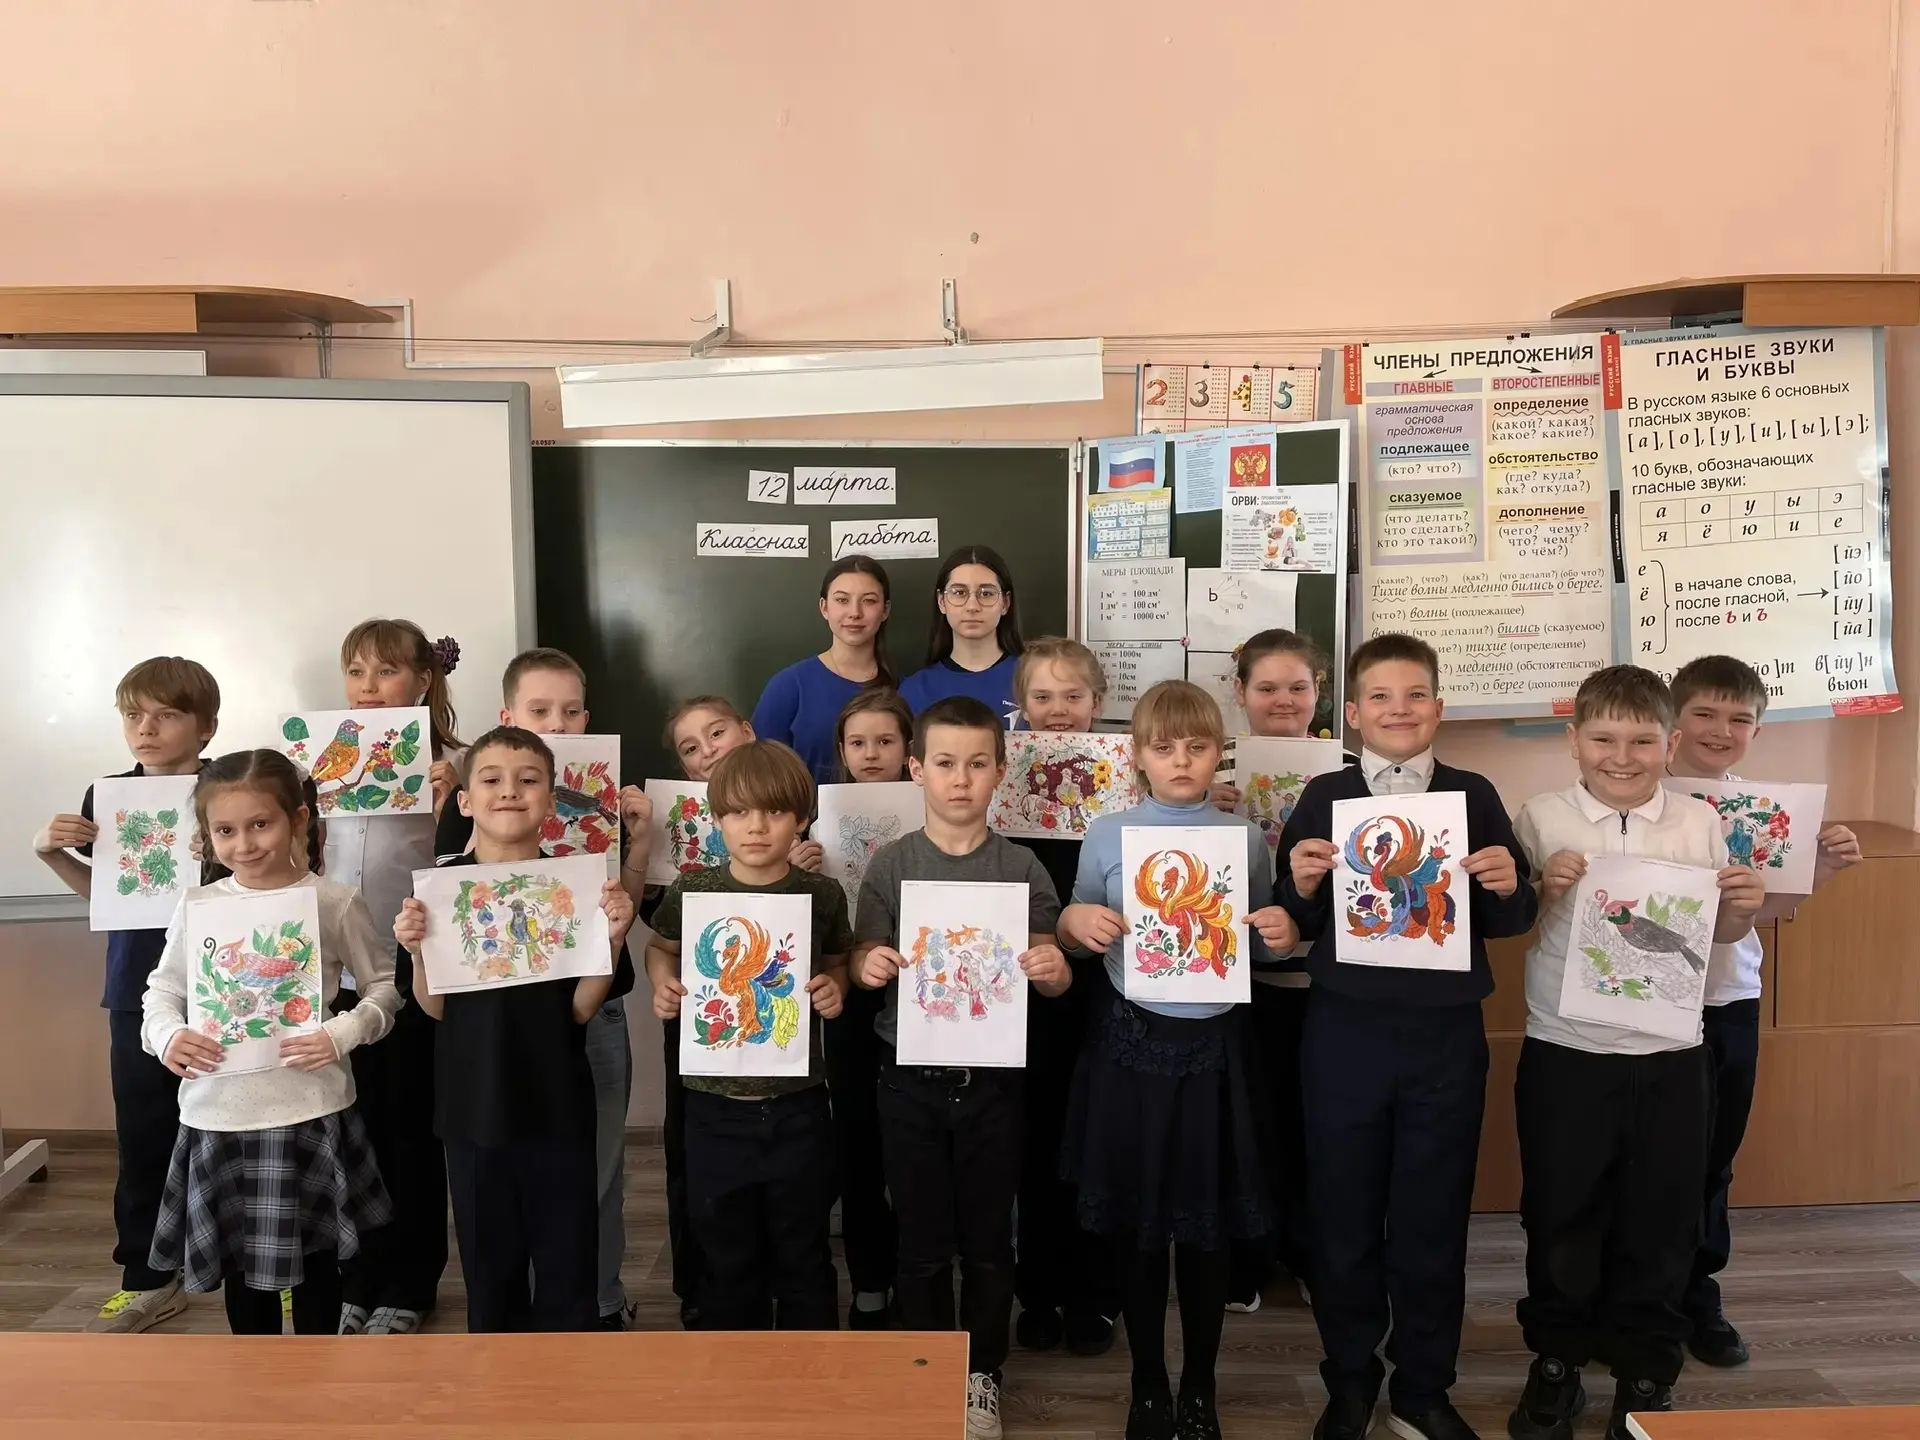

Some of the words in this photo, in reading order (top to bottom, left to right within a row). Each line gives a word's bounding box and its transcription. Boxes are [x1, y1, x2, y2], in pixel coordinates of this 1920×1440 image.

[1374, 353, 1440, 370] ЧЛЕНЫ
[1451, 345, 1594, 368] ПРЕДЛОЖЕНИЯ
[1656, 344, 1756, 368] ГЛАСНЫЕ
[1770, 338, 1834, 356] ЗВУКИ
[1697, 368, 1710, 382] И
[1725, 360, 1795, 380] БУКВЫ
[1394, 381, 1454, 394] ГЛАВНЫЕ
[1492, 374, 1600, 390] ВТОРОСТЕПЕННЫЕ
[1628, 397, 1638, 410] В
[1644, 392, 1706, 412] русском
[1711, 390, 1756, 404] языке
[1762, 386, 1772, 398] 6
[1775, 382, 1850, 398] основных
[1376, 404, 1474, 416] грамматическая
[1494, 397, 1590, 412] определение
[1404, 414, 1444, 424] основа
[1492, 418, 1542, 432] (какой?
[1548, 416, 1594, 428] какая?
[1628, 412, 1692, 428] гласных
[1696, 406, 1751, 422] звуков:
[1387, 426, 1462, 438] предложения
[1492, 429, 1536, 440] какое?
[1542, 426, 1594, 440] какие?)
[1380, 442, 1470, 455] подлежащее
[1489, 451, 1598, 465] обстоятельство
[1632, 464, 1650, 478] 10
[1654, 460, 1692, 477] букв,
[1698, 452, 1814, 472] обозначающих
[1388, 462, 1421, 476] (кто?
[1427, 462, 1462, 474] что?)
[1505, 471, 1538, 484] (где?
[1543, 470, 1582, 482] куда?
[758, 476, 786, 498] 12
[1496, 483, 1526, 495] как?
[1530, 480, 1590, 494] откуда?)
[1632, 480, 1696, 496] гласные
[1701, 474, 1746, 490] звуки:
[1232, 496, 1260, 506] ОРВИ:
[1390, 491, 1462, 504] сказуемое
[1787, 496, 1801, 508] ы
[1832, 492, 1843, 504] э
[1500, 506, 1585, 520] дополнение
[1745, 499, 1756, 517] у
[1385, 512, 1412, 526] (что
[1416, 511, 1468, 524] делать?
[1834, 516, 1843, 528] е
[1384, 527, 1406, 535] что
[1412, 522, 1470, 534] сделать?
[1498, 526, 1539, 539] (чего?
[1549, 523, 1590, 536] чему?
[1702, 525, 1712, 538] ё
[1742, 524, 1758, 536] ю
[1789, 521, 1800, 532] и
[700, 528, 808, 550] Классная
[1377, 538, 1398, 548] кто
[1402, 537, 1424, 546] это
[1428, 533, 1478, 546] такой?)
[1508, 536, 1538, 548] что?
[1543, 534, 1575, 545] чем?
[1656, 531, 1668, 542] я
[1519, 549, 1526, 557] о
[1532, 546, 1568, 558] чём?)
[1102, 568, 1126, 576] МЕРЫ
[1130, 566, 1174, 576] ПЛОЩАДИ
[1462, 573, 1488, 582] (как?)
[1500, 572, 1518, 582] (что
[1519, 570, 1558, 580] делали?)
[1560, 569, 1579, 578] (обо
[1580, 568, 1605, 578] что?)
[1638, 564, 1648, 577] е
[1376, 575, 1413, 586] (какие?)
[1421, 574, 1448, 584] (что?)
[1675, 582, 1684, 592] в
[1688, 578, 1742, 591] начале
[1747, 573, 1796, 588] слова,
[1372, 584, 1408, 597] Тихие
[1410, 583, 1448, 596] волны
[1450, 582, 1508, 595] медленно
[1511, 579, 1554, 592] бились
[1556, 582, 1564, 590] о
[1567, 578, 1602, 592] берег.
[1640, 587, 1649, 602] ё
[1133, 601, 1146, 609] 100
[1676, 597, 1720, 610] после
[1726, 589, 1790, 606] гласной,
[1372, 610, 1406, 622] (что?)
[1410, 606, 1448, 619] волны
[1452, 605, 1525, 618] (подлежащее)
[1676, 614, 1720, 628] после
[1742, 612, 1751, 622] и
[1640, 615, 1656, 627] ю
[1412, 628, 1436, 638] (что
[1440, 624, 1494, 637] делали?)
[1498, 622, 1540, 635] бились
[1544, 621, 1605, 634] (сказуемое)
[1466, 641, 1506, 653] тихие
[1510, 640, 1586, 653] (определение)
[1640, 641, 1652, 652] я
[1456, 660, 1514, 674] медленно
[1516, 658, 1604, 673] (обстоятельство)
[1449, 681, 1480, 693] что?)
[1482, 682, 1490, 690] о
[1492, 679, 1524, 694] берег
[1828, 676, 1868, 692] вьюн
